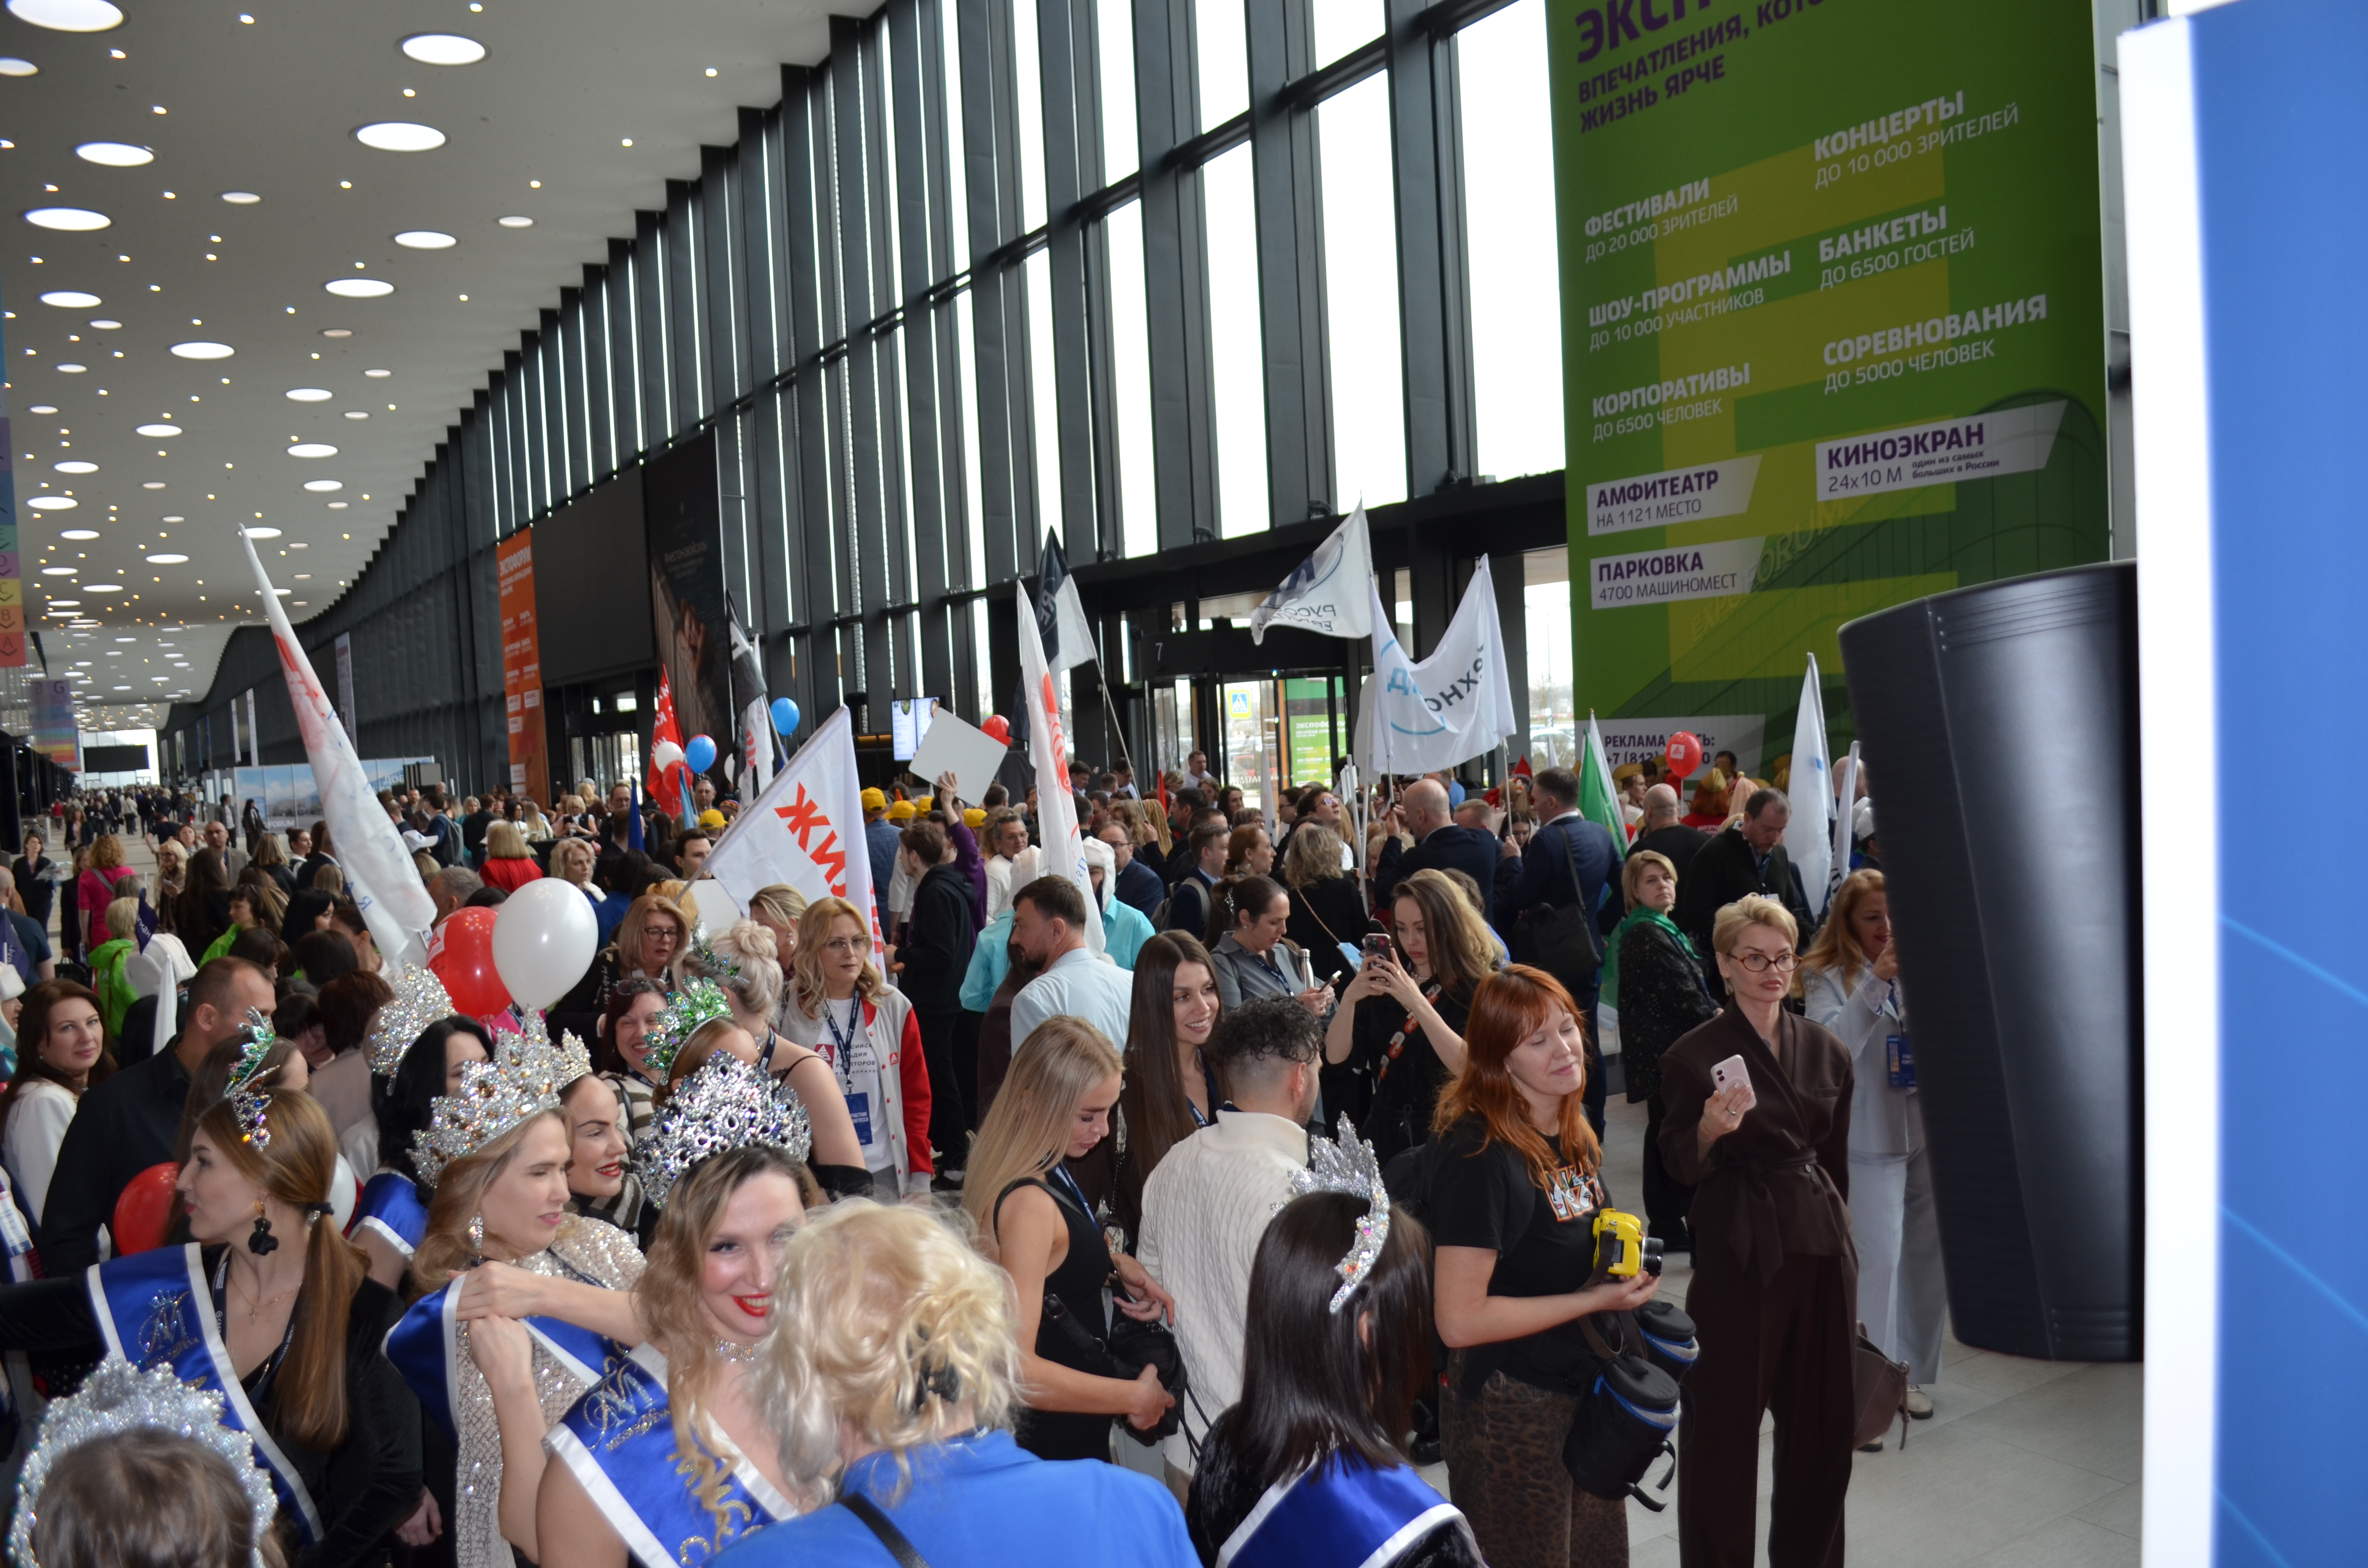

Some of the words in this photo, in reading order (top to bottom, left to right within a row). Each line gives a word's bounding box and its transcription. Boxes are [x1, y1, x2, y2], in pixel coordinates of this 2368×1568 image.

[1579, 14, 1749, 103] ВПЕЧАТЛЕНИЯ,
[1580, 85, 1658, 134] ЖИЗНЬ
[1665, 54, 1725, 99] ЯРЧЕ
[1814, 89, 1964, 162] КОНЦЕРТЫ
[1815, 163, 1841, 191] ДО
[1848, 154, 1870, 174] 10
[1874, 141, 1912, 167] 000
[1917, 101, 2018, 154] ЗРИТЕЛЕЙ
[1585, 177, 1710, 236] ФЕСТИВАЛИ
[1586, 241, 1605, 264] ДО
[1609, 234, 1627, 253] 20
[1630, 223, 1659, 245] 000
[1662, 193, 1739, 236] ЗРИТЕЛЕЙ
[1819, 205, 1947, 263] БАНКЕТЫ
[1820, 265, 1846, 292] ДО
[1850, 251, 1899, 279] 6500
[1904, 226, 1974, 266] ГОСТЕЙ
[1589, 250, 1791, 328] ШОУ-ПРОГРАММЫ
[1590, 330, 1609, 353] ДО
[1614, 324, 1631, 342] 10
[1634, 315, 1663, 337] 000
[1666, 287, 1764, 329] УЧАСТНИКОВ
[1823, 293, 2047, 366] СОРЕВНОВАНИЯ
[1592, 362, 1750, 418] КОРПОРАТИВЫ
[1824, 370, 1850, 395] ДО
[1855, 359, 1904, 385] 5000
[1908, 338, 1996, 372] ЧЕЛОВЕК
[1593, 421, 1613, 443] ДО
[1616, 413, 1654, 434] 6500
[1657, 397, 1723, 425] ЧЕЛОВЕК
[1828, 422, 1984, 470] КИНОЭКРАН
[1912, 458, 1936, 469] один
[1938, 456, 1949, 464] из
[1952, 450, 1984, 463] самых
[1912, 466, 1954, 479] больших
[1965, 459, 1999, 471] России
[1596, 469, 1719, 508] АМФИТЕАТР
[1597, 513, 1615, 528] НА
[1618, 508, 1652, 524] 1121
[1655, 498, 1702, 519] МЕСТО
[1598, 551, 1704, 582] ПАРКОВКА
[1599, 584, 1633, 602] 4700
[1636, 573, 1737, 599] МАШИНОМЕСТ
[1155, 642, 1163, 662] 7
[1604, 734, 1666, 747] РЕКЛАМА
